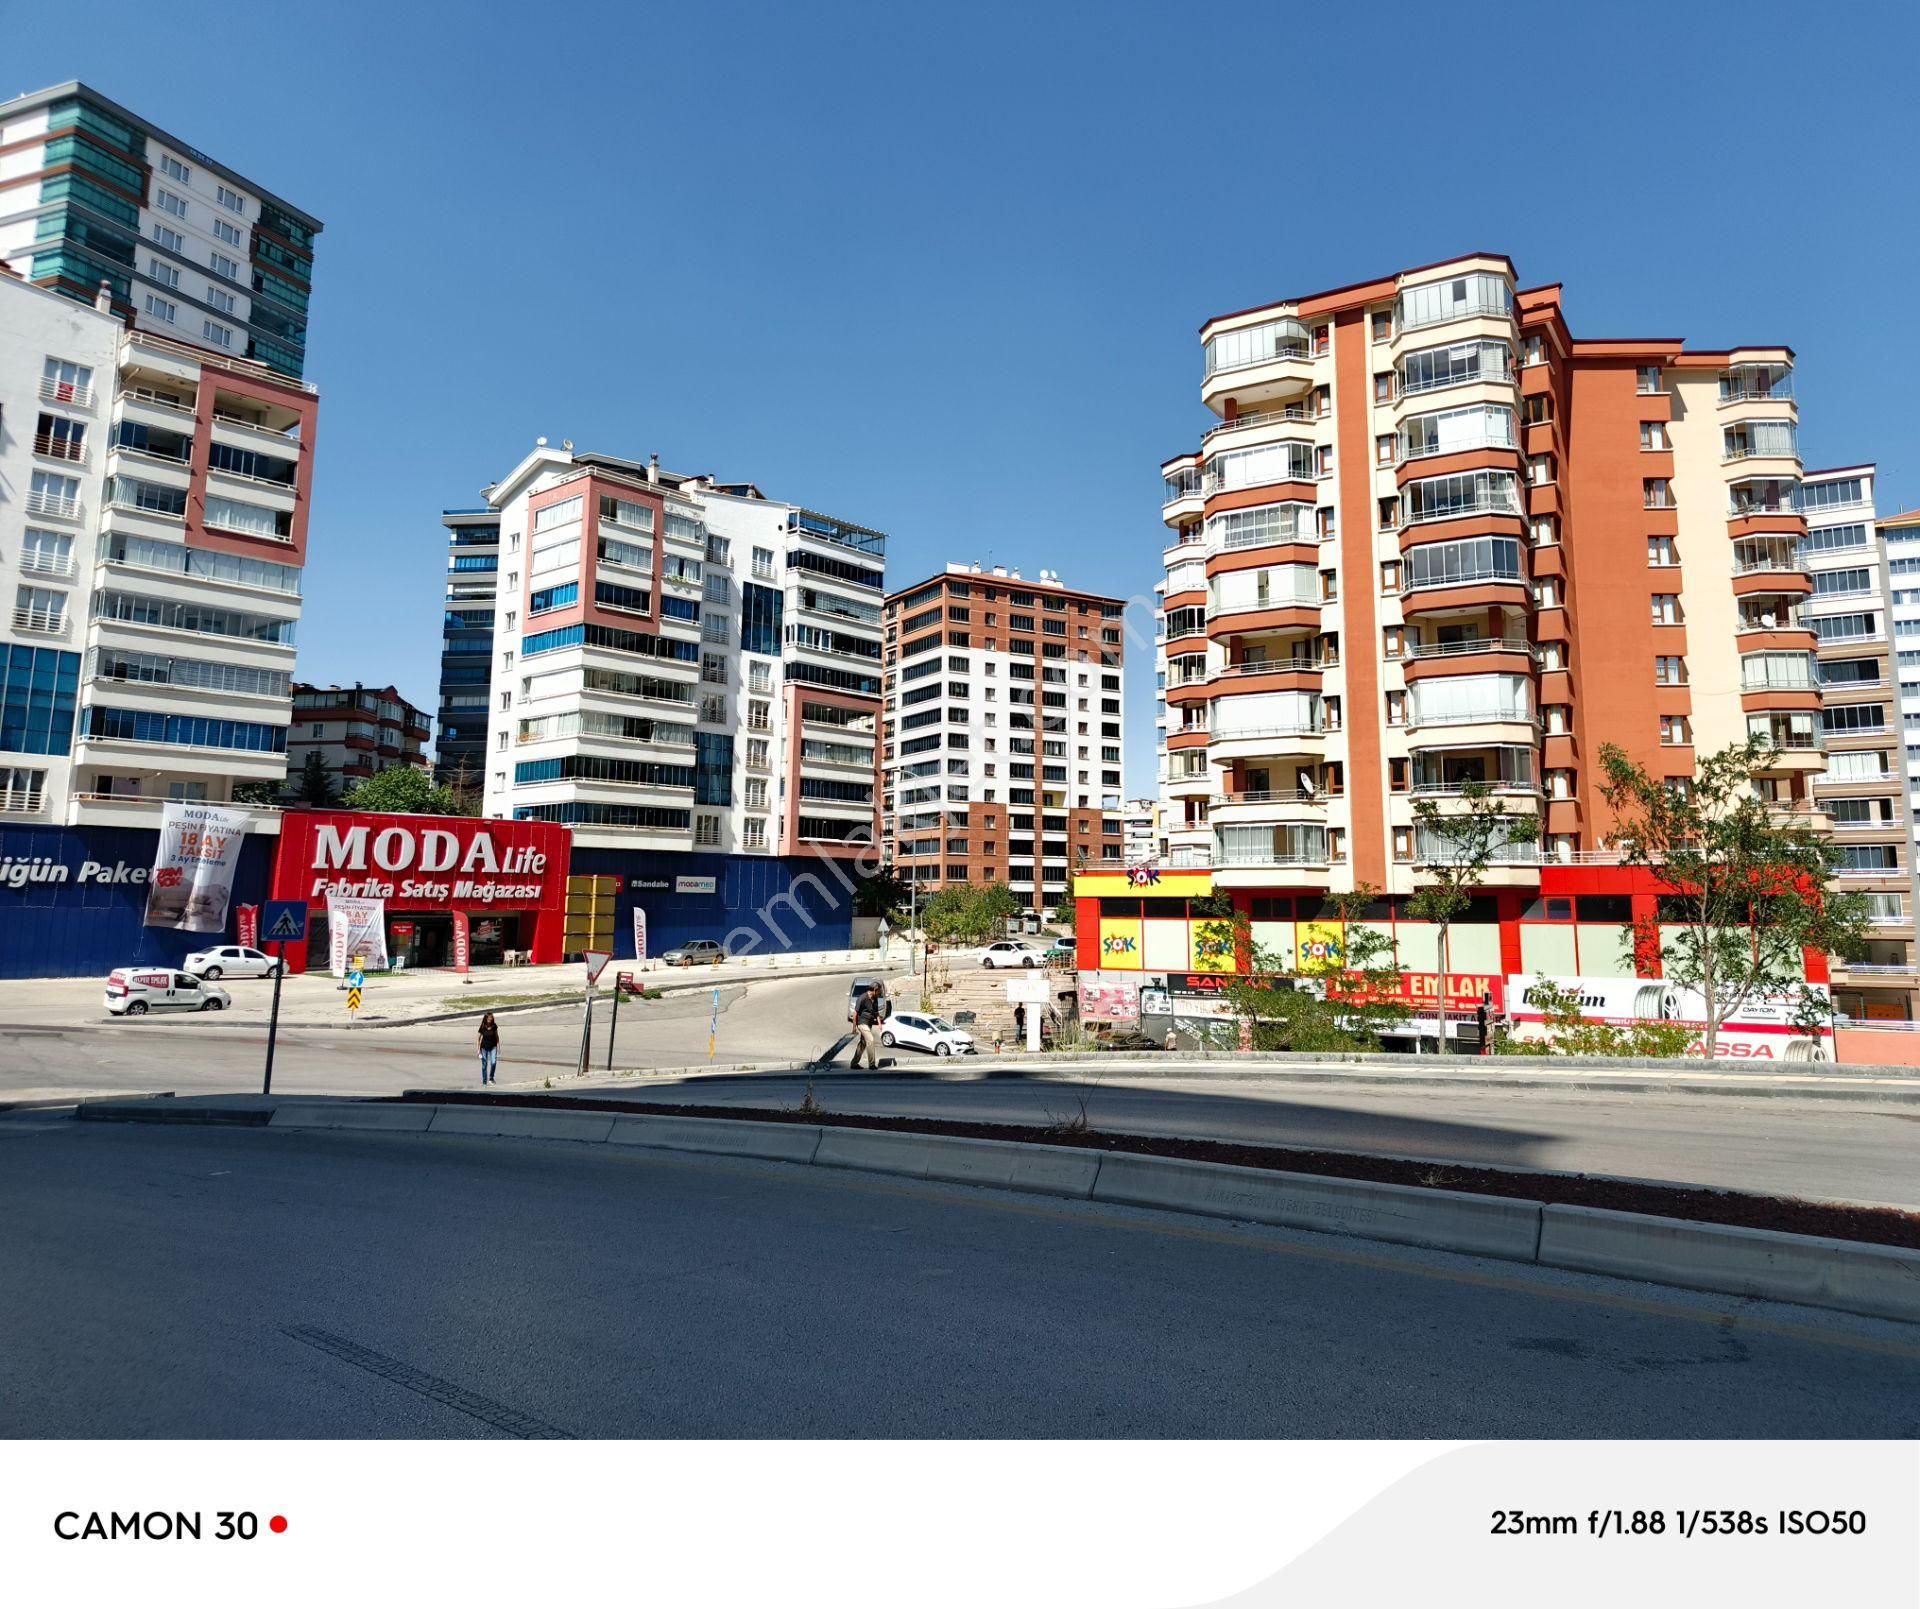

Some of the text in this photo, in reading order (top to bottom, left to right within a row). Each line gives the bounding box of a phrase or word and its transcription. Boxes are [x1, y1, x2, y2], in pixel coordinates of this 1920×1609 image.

[184, 810, 219, 822] MODA
[181, 832, 228, 849] 18 AY
[311, 824, 547, 874] MODA Life
[177, 856, 190, 865] Ay
[1126, 868, 1161, 889] ŞOK
[311, 877, 542, 903] Fabrika Satış Mağazası
[456, 930, 466, 966] MODA
[637, 924, 645, 955] MODA
[1103, 935, 1136, 955] ŞOK
[1410, 975, 1490, 998] EMLAK
[1742, 1006, 1777, 1014] DAYTON
[1687, 1040, 1775, 1059] ASSA
